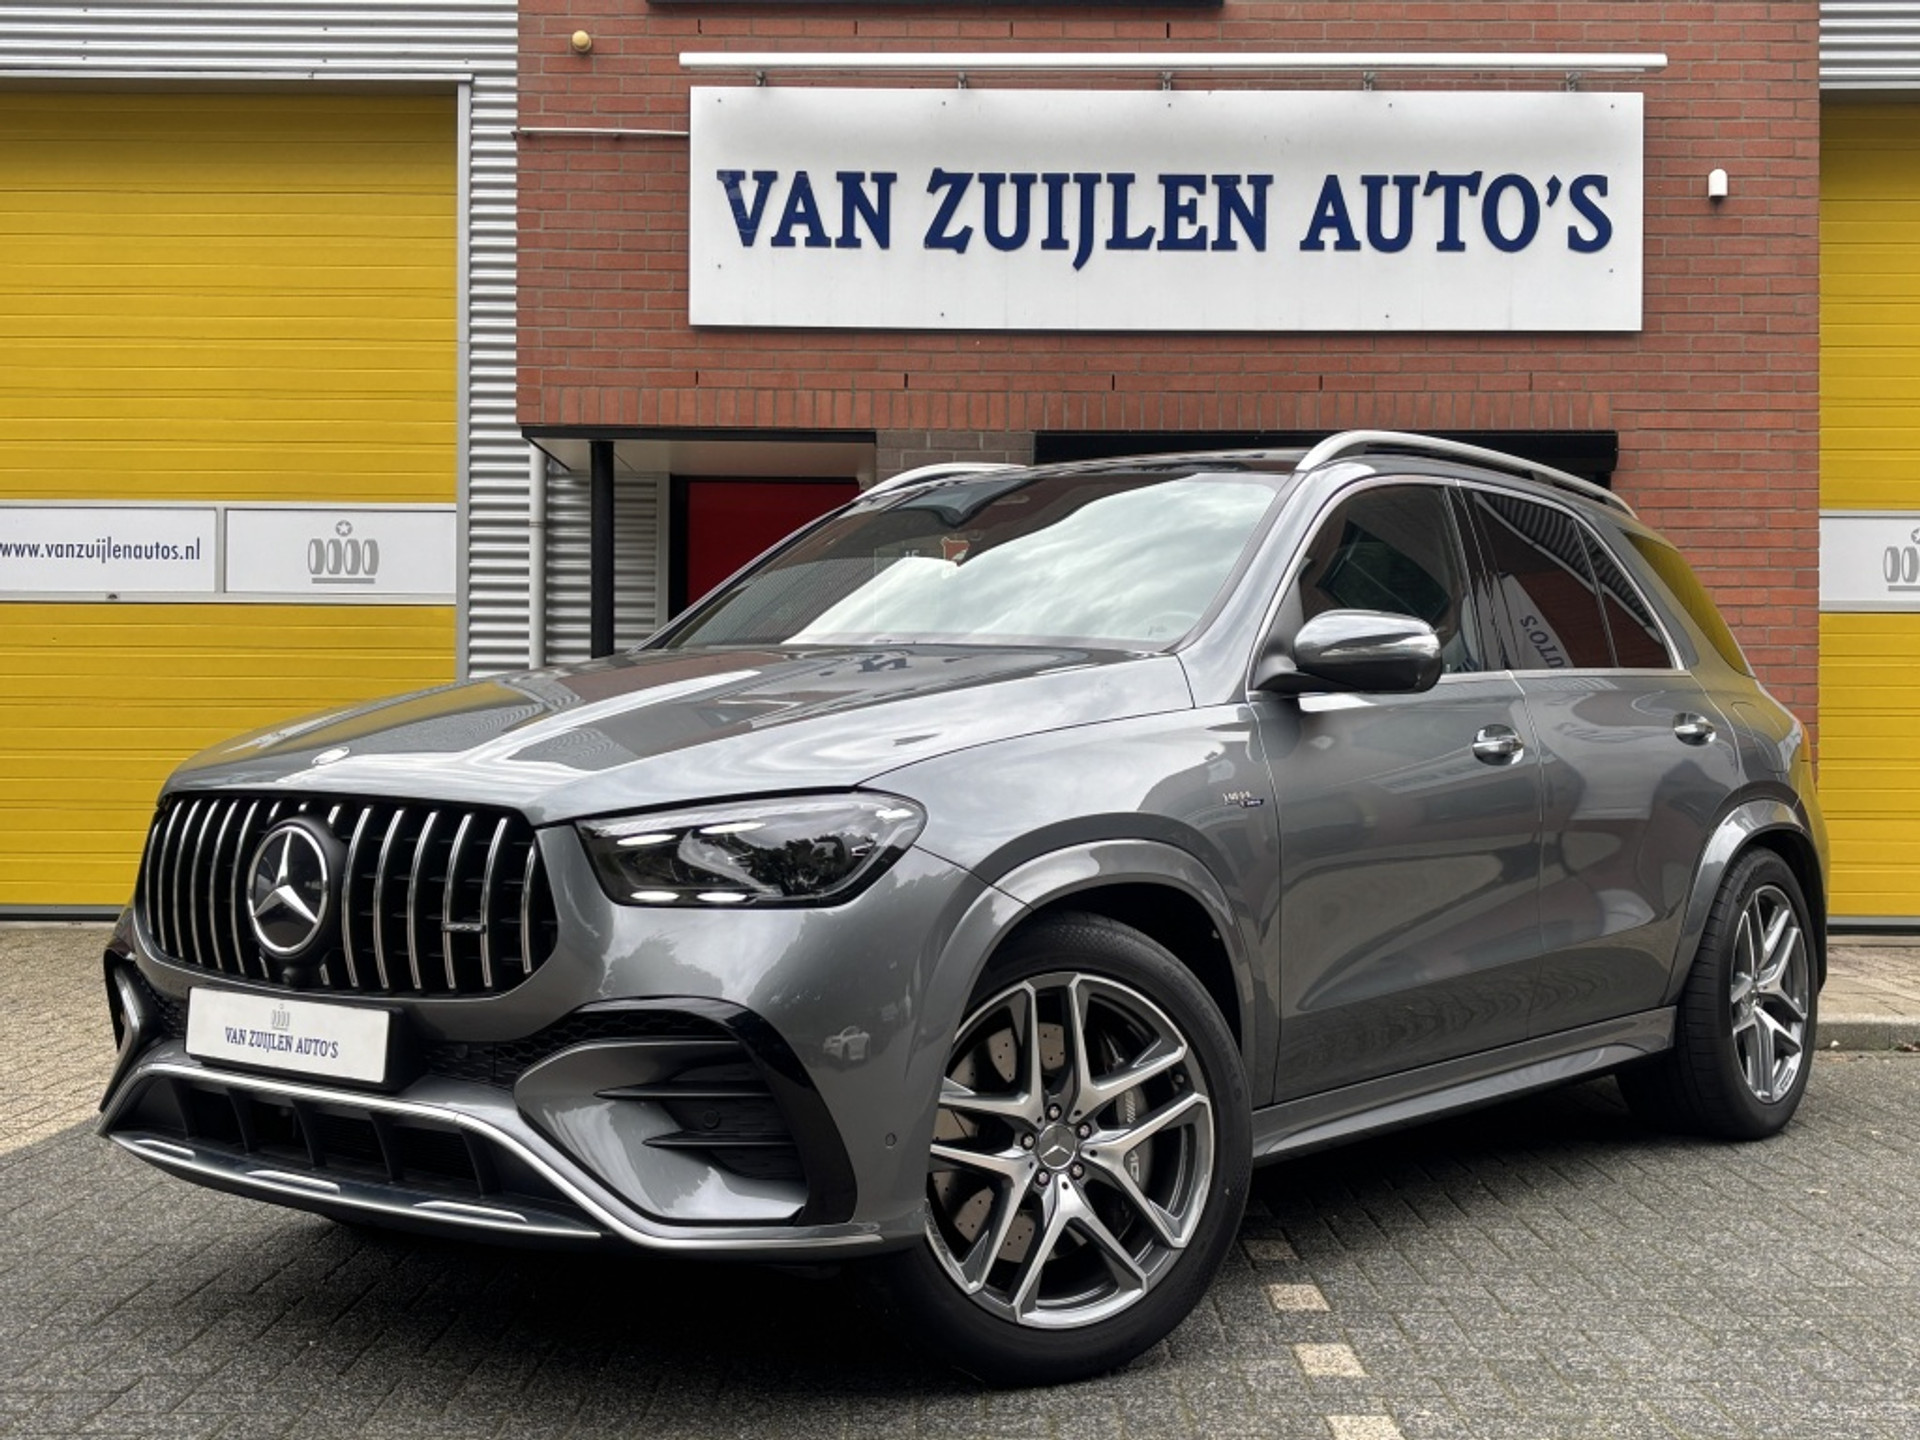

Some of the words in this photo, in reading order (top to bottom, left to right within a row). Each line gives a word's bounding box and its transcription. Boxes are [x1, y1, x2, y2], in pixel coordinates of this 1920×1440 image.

[716, 170, 898, 250] VAN
[923, 167, 1274, 272] ZUIJLEN
[1299, 170, 1612, 253] AUTO'S
[0, 536, 201, 564] www.vanzuijlenautos.nl
[1520, 615, 1565, 668] UTO'S
[225, 1026, 247, 1045] VAN
[249, 1030, 294, 1053] ZUIJLEN
[295, 1037, 339, 1059] AUTO'S
